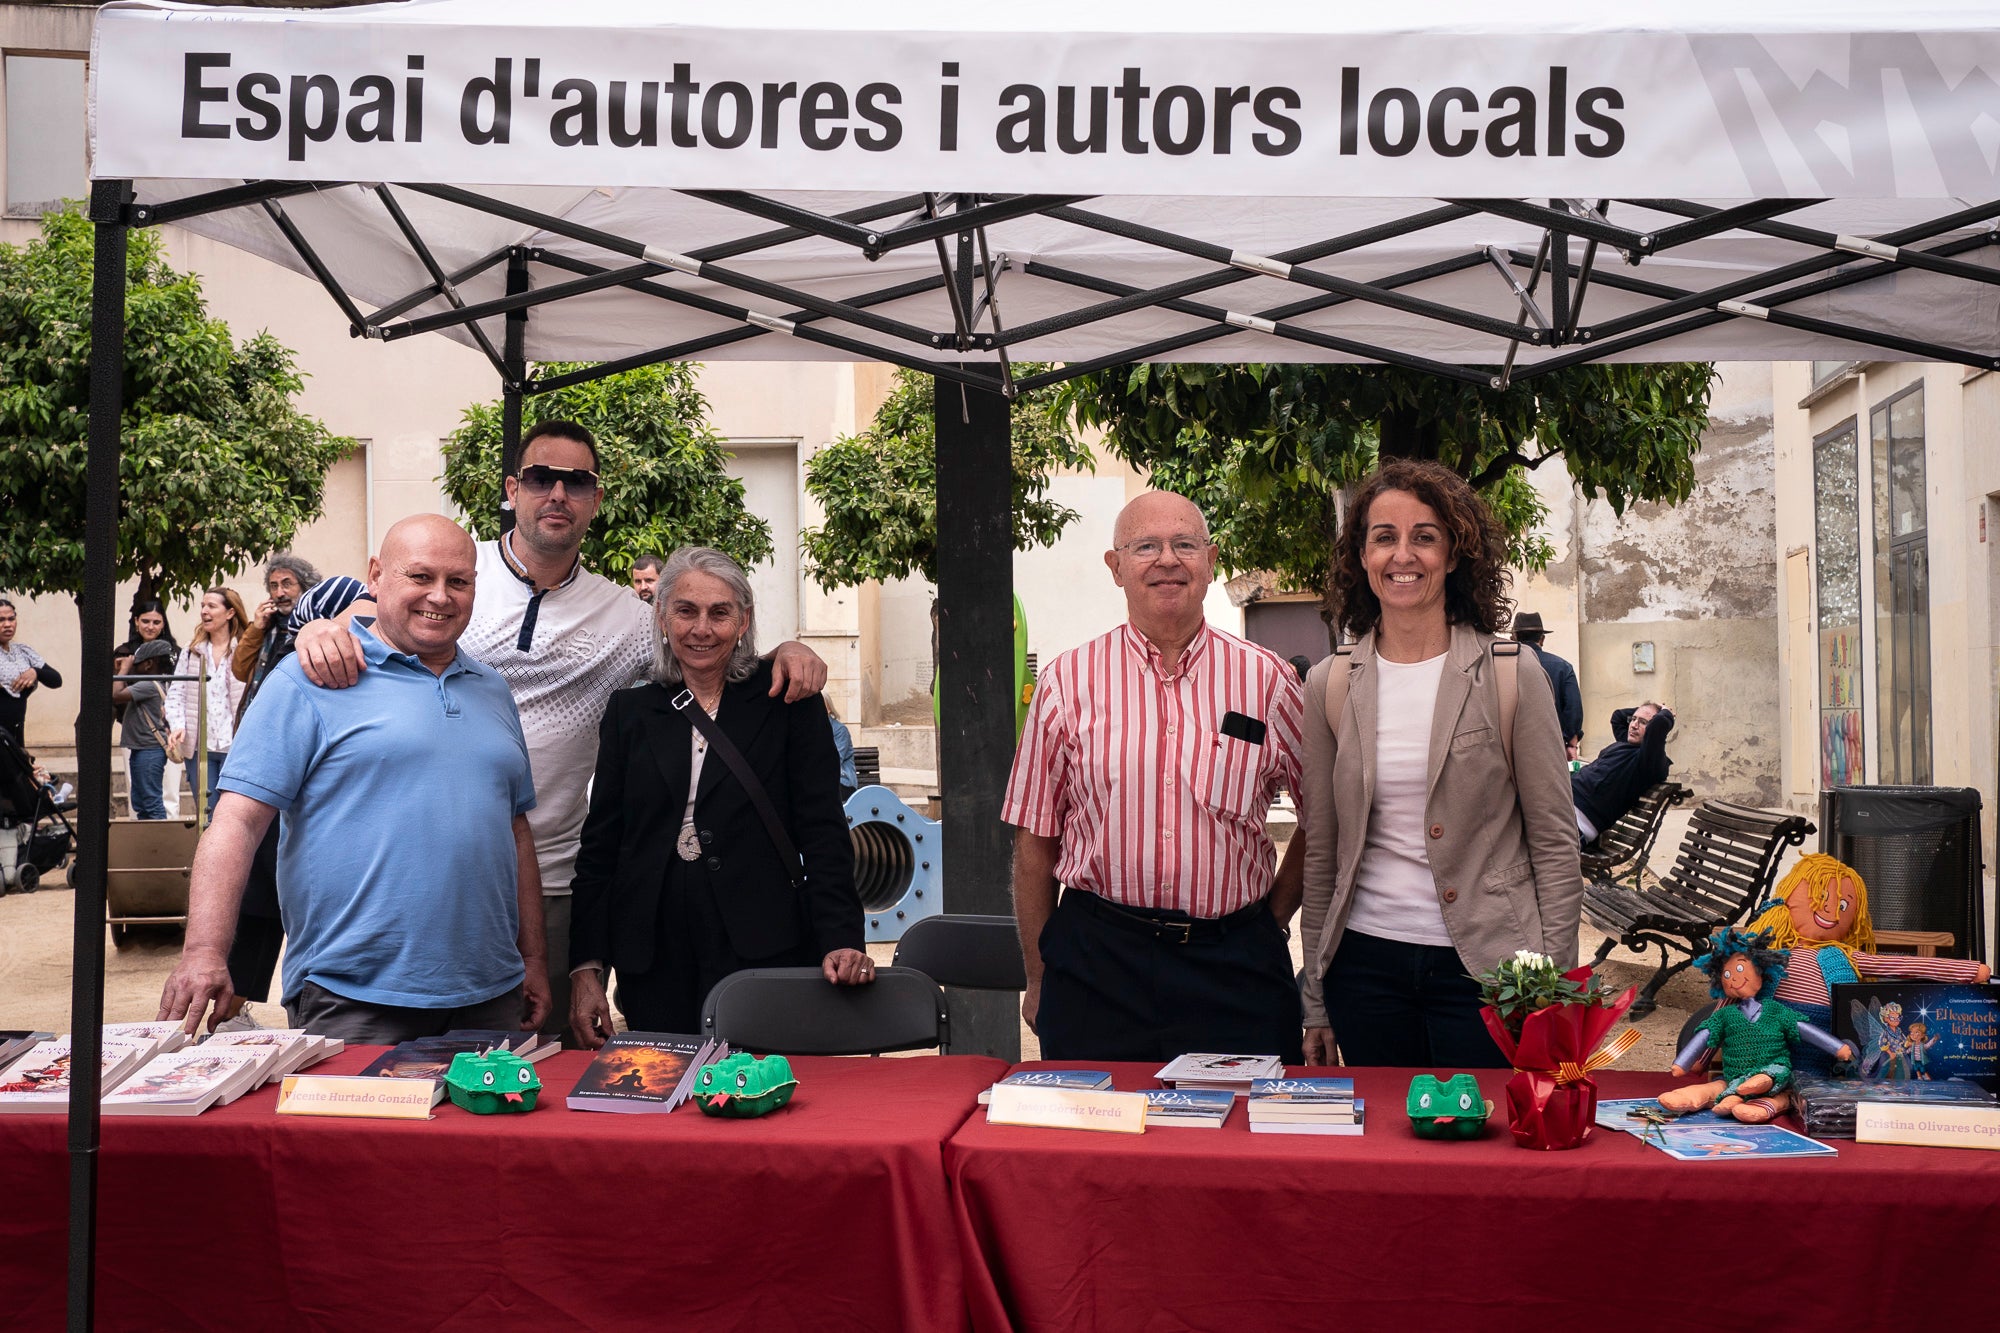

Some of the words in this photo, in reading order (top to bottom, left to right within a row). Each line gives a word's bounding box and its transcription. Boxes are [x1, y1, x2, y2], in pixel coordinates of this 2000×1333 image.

[182, 53, 424, 161] Espai
[461, 58, 902, 151] d'autores
[940, 62, 959, 151] i
[996, 68, 1301, 156] autors
[1340, 66, 1624, 158] locals
[1936, 1008, 1948, 1020] El
[1950, 1009, 1982, 1026] legado
[1983, 1011, 1998, 1022] de
[1952, 1023, 1960, 1034] la
[1962, 1024, 1997, 1037] abuela
[1971, 1038, 1997, 1050] hada
[1263, 1080, 1298, 1088] AJO
[285, 1091, 326, 1101] Vicente
[329, 1092, 375, 1103] Hurtado
[378, 1093, 429, 1105] González
[1088, 1106, 1121, 1117] Verdú
[1865, 1118, 1915, 1130] Cristina
[1918, 1121, 1970, 1133] Olivares
